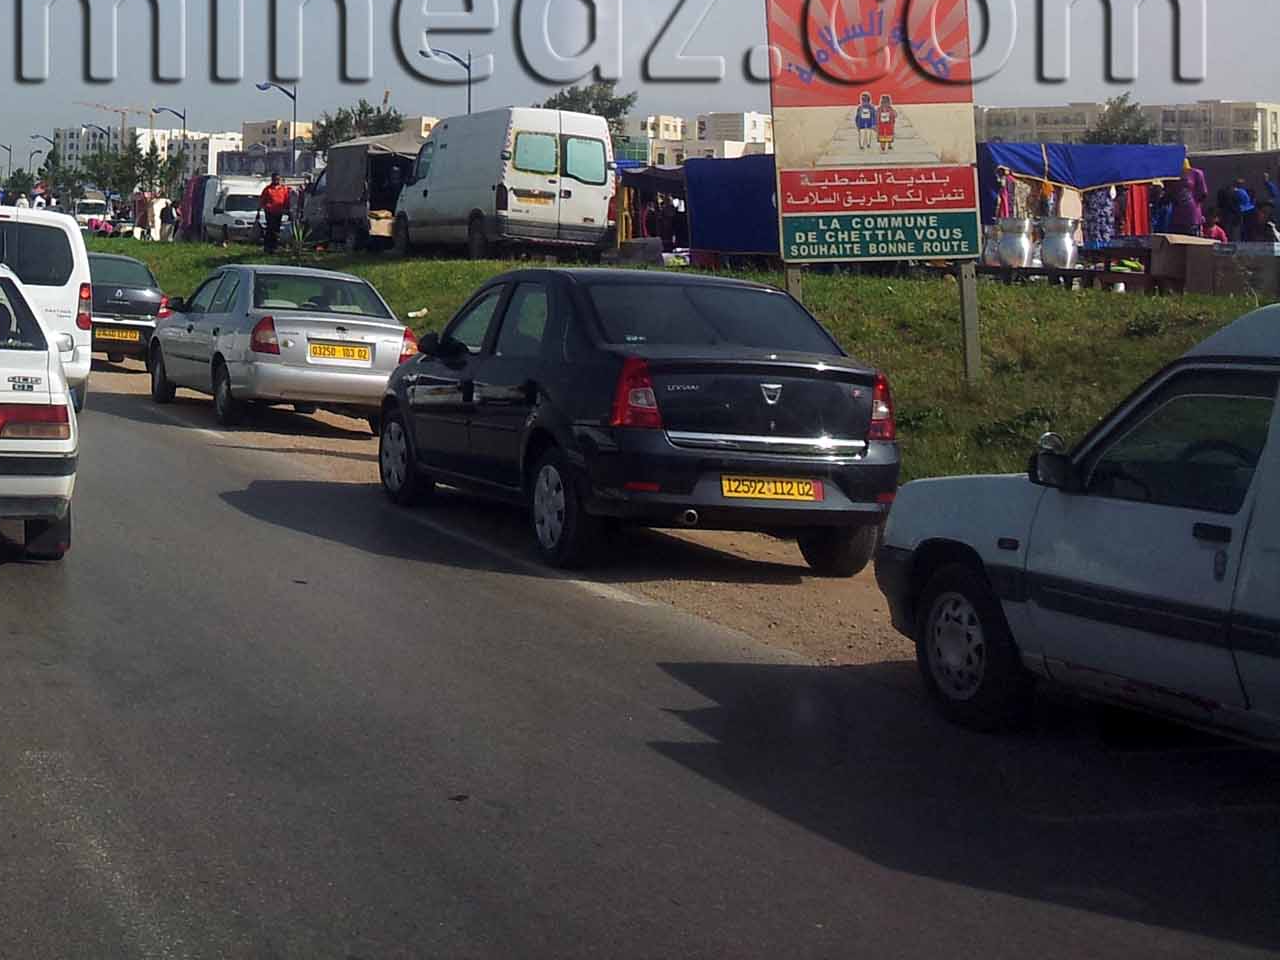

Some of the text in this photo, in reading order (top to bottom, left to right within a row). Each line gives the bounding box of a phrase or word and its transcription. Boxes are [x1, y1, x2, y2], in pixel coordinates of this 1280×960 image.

[800, 171, 950, 189] بلدية الشطية
[786, 191, 840, 205] السلامة
[842, 190, 888, 208] طريق
[891, 189, 923, 209] لكم
[819, 215, 939, 230] LA COMMUNE
[795, 228, 963, 243] DE CHETTIA VOUS
[790, 240, 970, 256] SOUHAITE BONNE ROUTE
[726, 478, 814, 497] 12592 112 02
